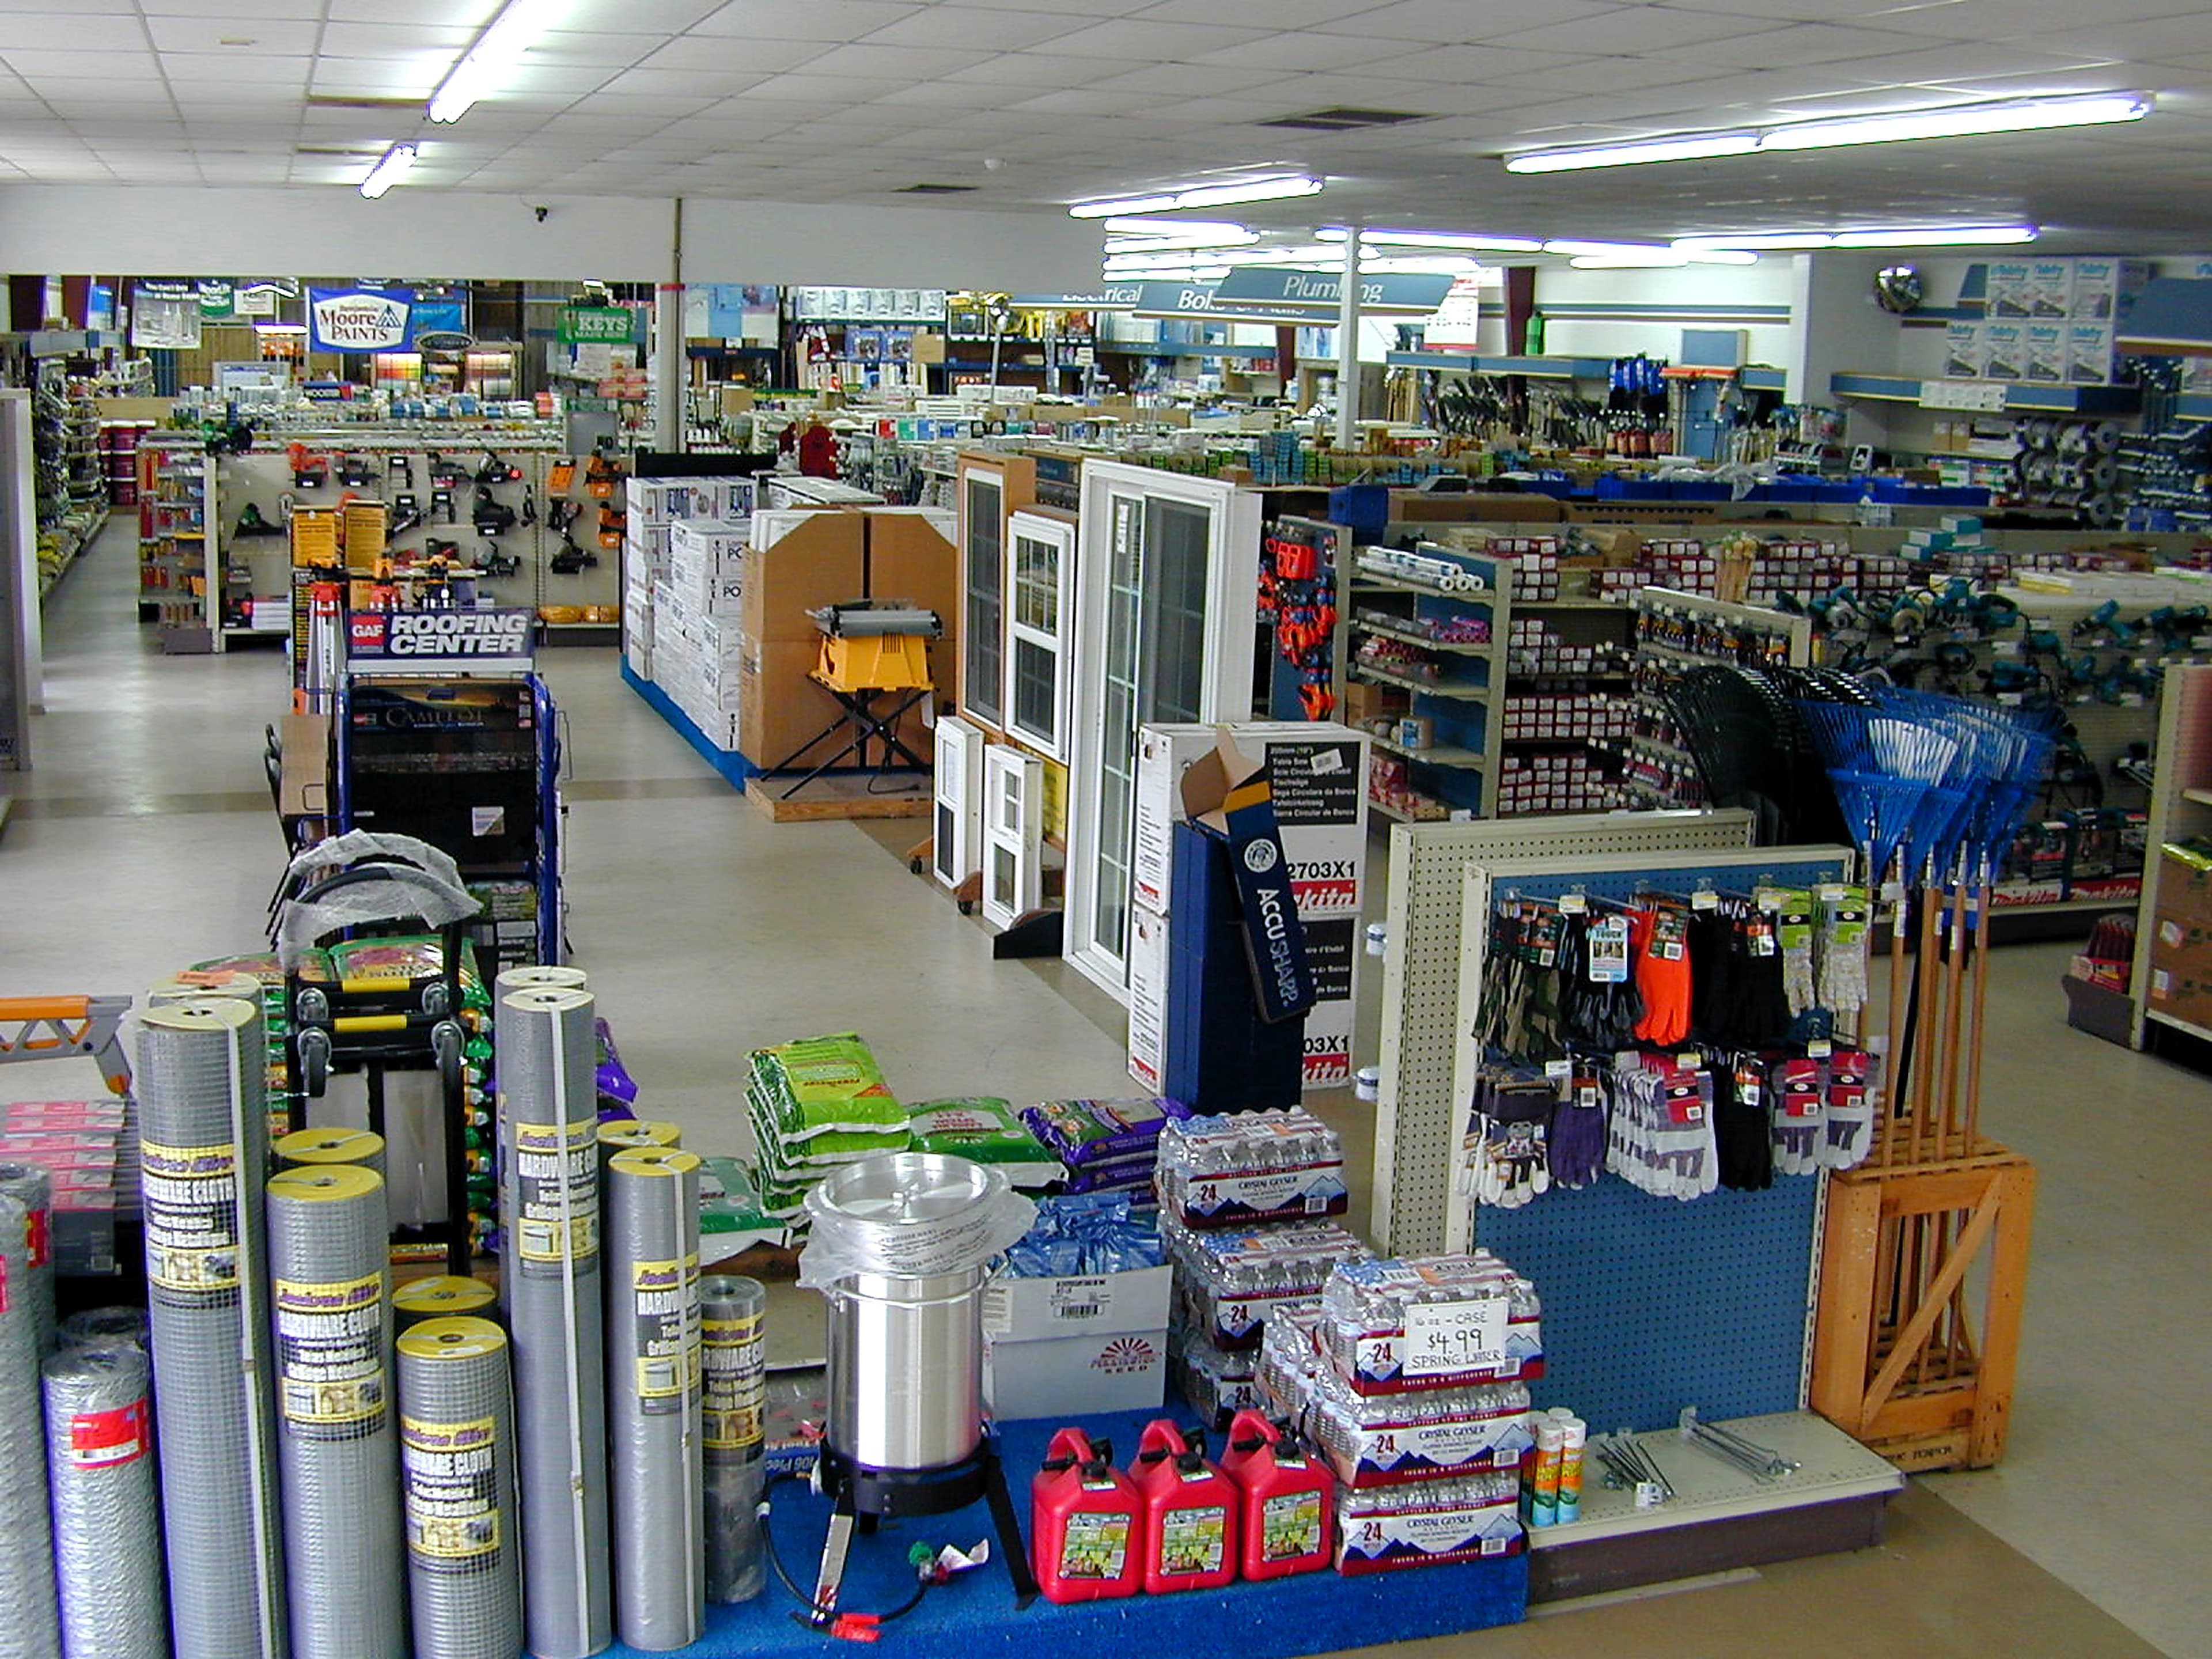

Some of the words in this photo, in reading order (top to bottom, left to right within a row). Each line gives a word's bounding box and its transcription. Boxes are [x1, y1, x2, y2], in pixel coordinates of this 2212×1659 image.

[1283, 275, 1384, 303] Plumng
[1177, 289, 1225, 310] Bol
[320, 309, 377, 326] Moore
[578, 317, 627, 331] KEYS
[331, 326, 388, 341] PAINTS
[352, 624, 385, 638] GAF
[391, 615, 528, 635] ROOFING
[390, 635, 525, 655] CENTER
[1286, 861, 1355, 879] 2703X1
[1200, 1184, 1217, 1202] 24
[1230, 1305, 1248, 1322] 24
[1455, 1311, 1488, 1324] CASE
[1427, 1328, 1482, 1354] $4.99
[1373, 1342, 1392, 1363] 24
[1411, 1354, 1461, 1369] SPRING
[1235, 1386, 1252, 1404] 24
[1419, 1429, 1451, 1440] CRYSTAL
[1453, 1425, 1487, 1436] GEYSER
[1376, 1435, 1395, 1453] 24
[1407, 1518, 1440, 1528] CRYSTAL
[1441, 1515, 1475, 1526] GEYSER
[1363, 1522, 1381, 1541] 24
